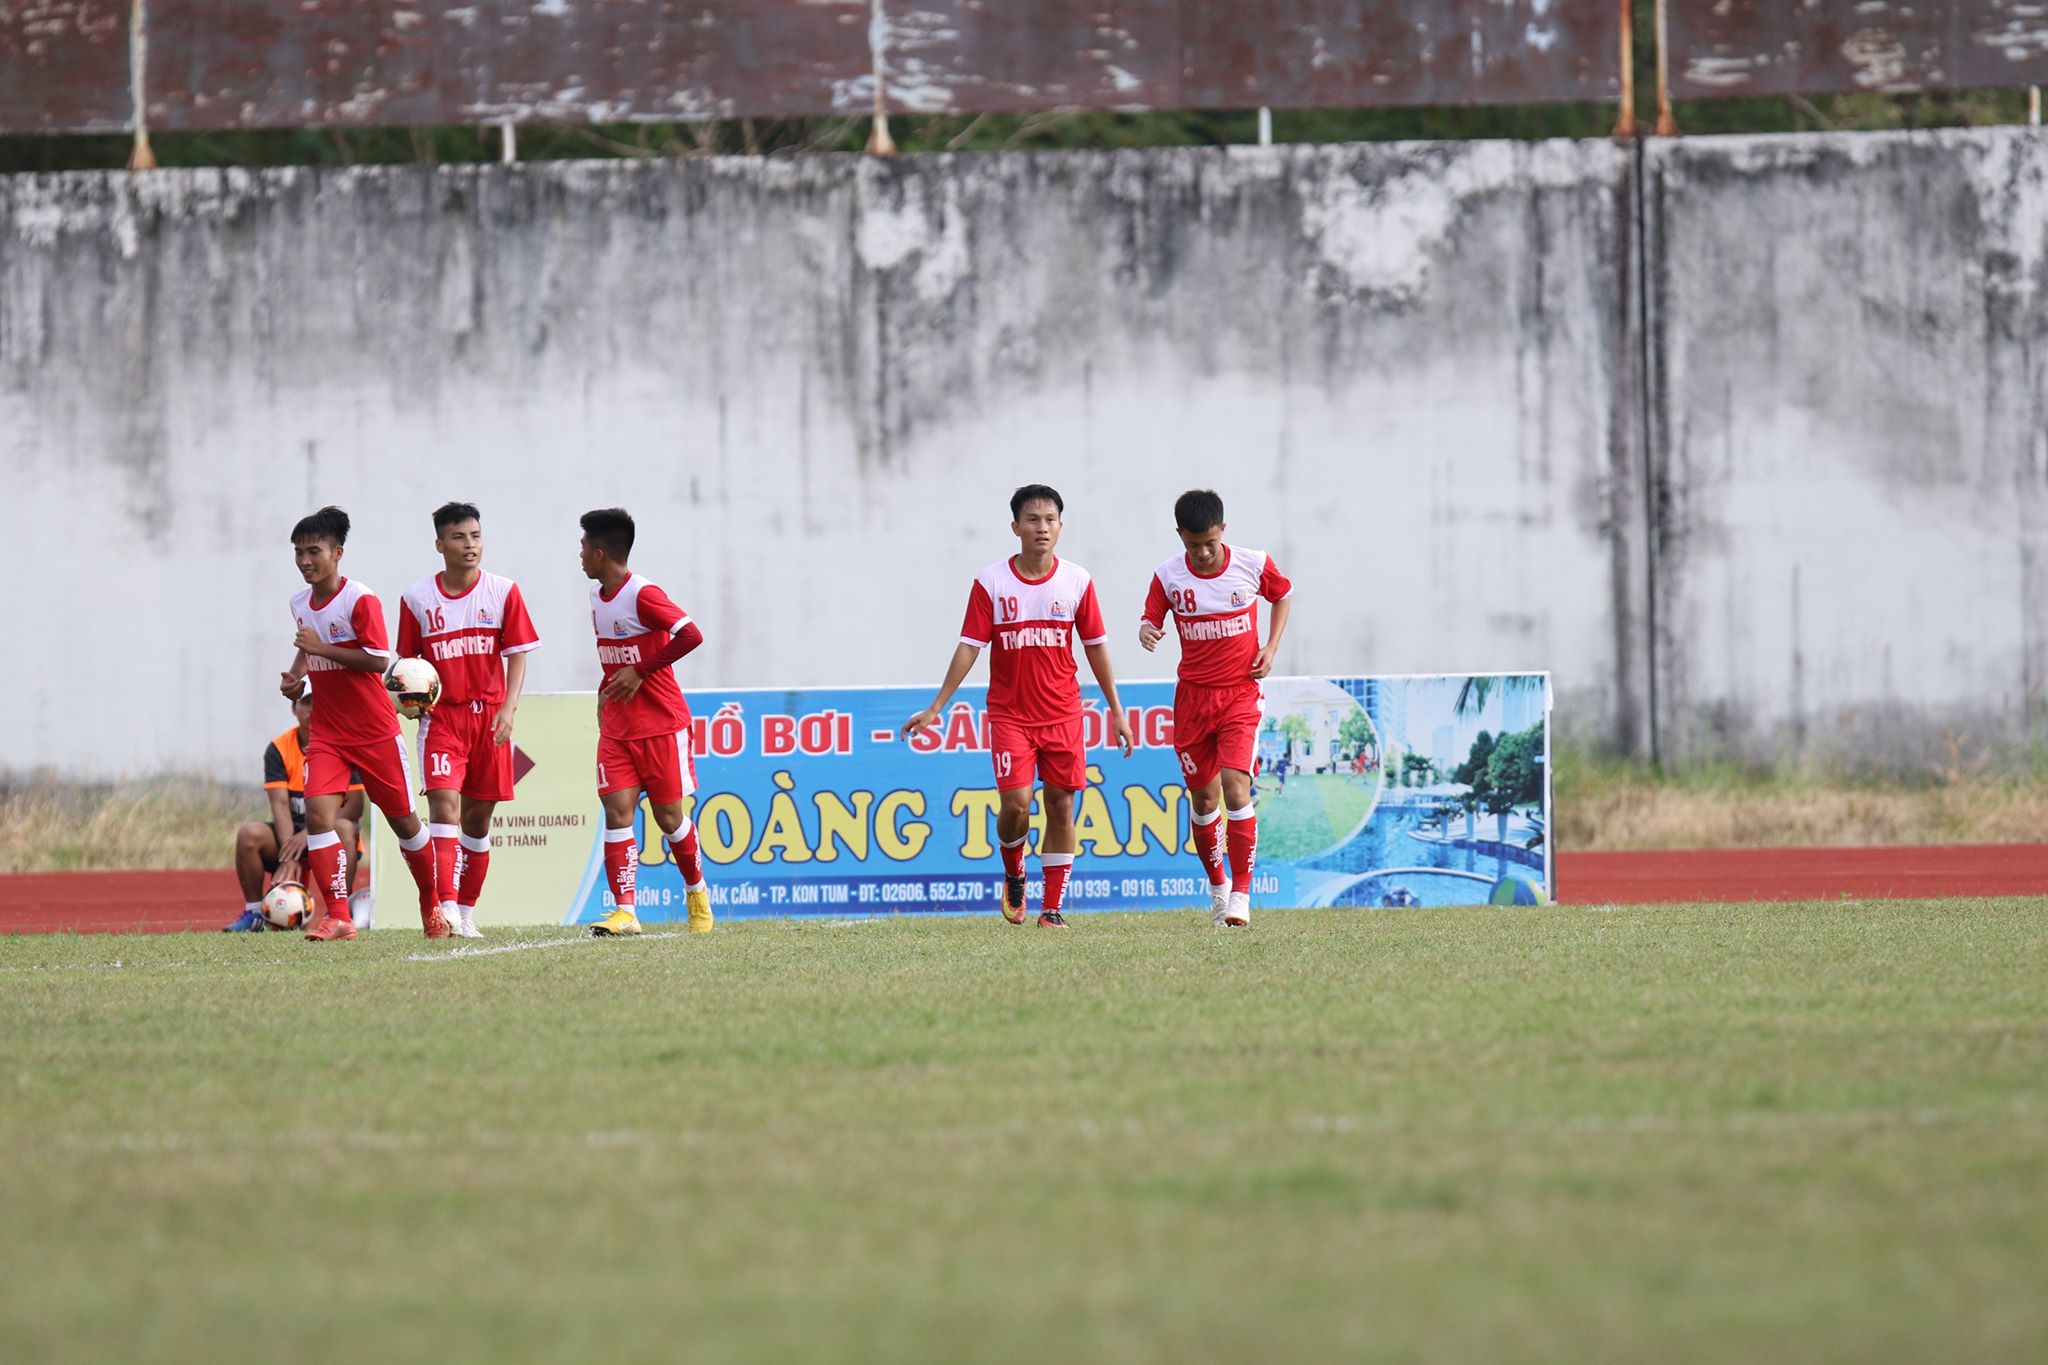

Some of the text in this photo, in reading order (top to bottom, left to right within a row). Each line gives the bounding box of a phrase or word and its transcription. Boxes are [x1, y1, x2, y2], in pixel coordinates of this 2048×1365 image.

[999, 596, 1018, 621] 19
[1172, 588, 1197, 613] 28
[425, 607, 445, 633] 16
[761, 710, 852, 756] BƠI
[431, 753, 451, 776] 16
[996, 751, 1012, 778] 19
[506, 815, 535, 828] VINH
[538, 814, 579, 828] QUANG
[506, 832, 547, 847] THÀNH
[662, 888, 671, 906] 9
[731, 881, 759, 905] CẤM
[770, 885, 790, 904] TP.
[792, 884, 818, 903] KON
[821, 884, 849, 903] TUM
[859, 884, 880, 902] ĐT:
[882, 882, 927, 901] 02606.
[929, 881, 984, 901] 552.570
[1085, 879, 1111, 897] 939
[1121, 879, 1158, 897] 0916.
